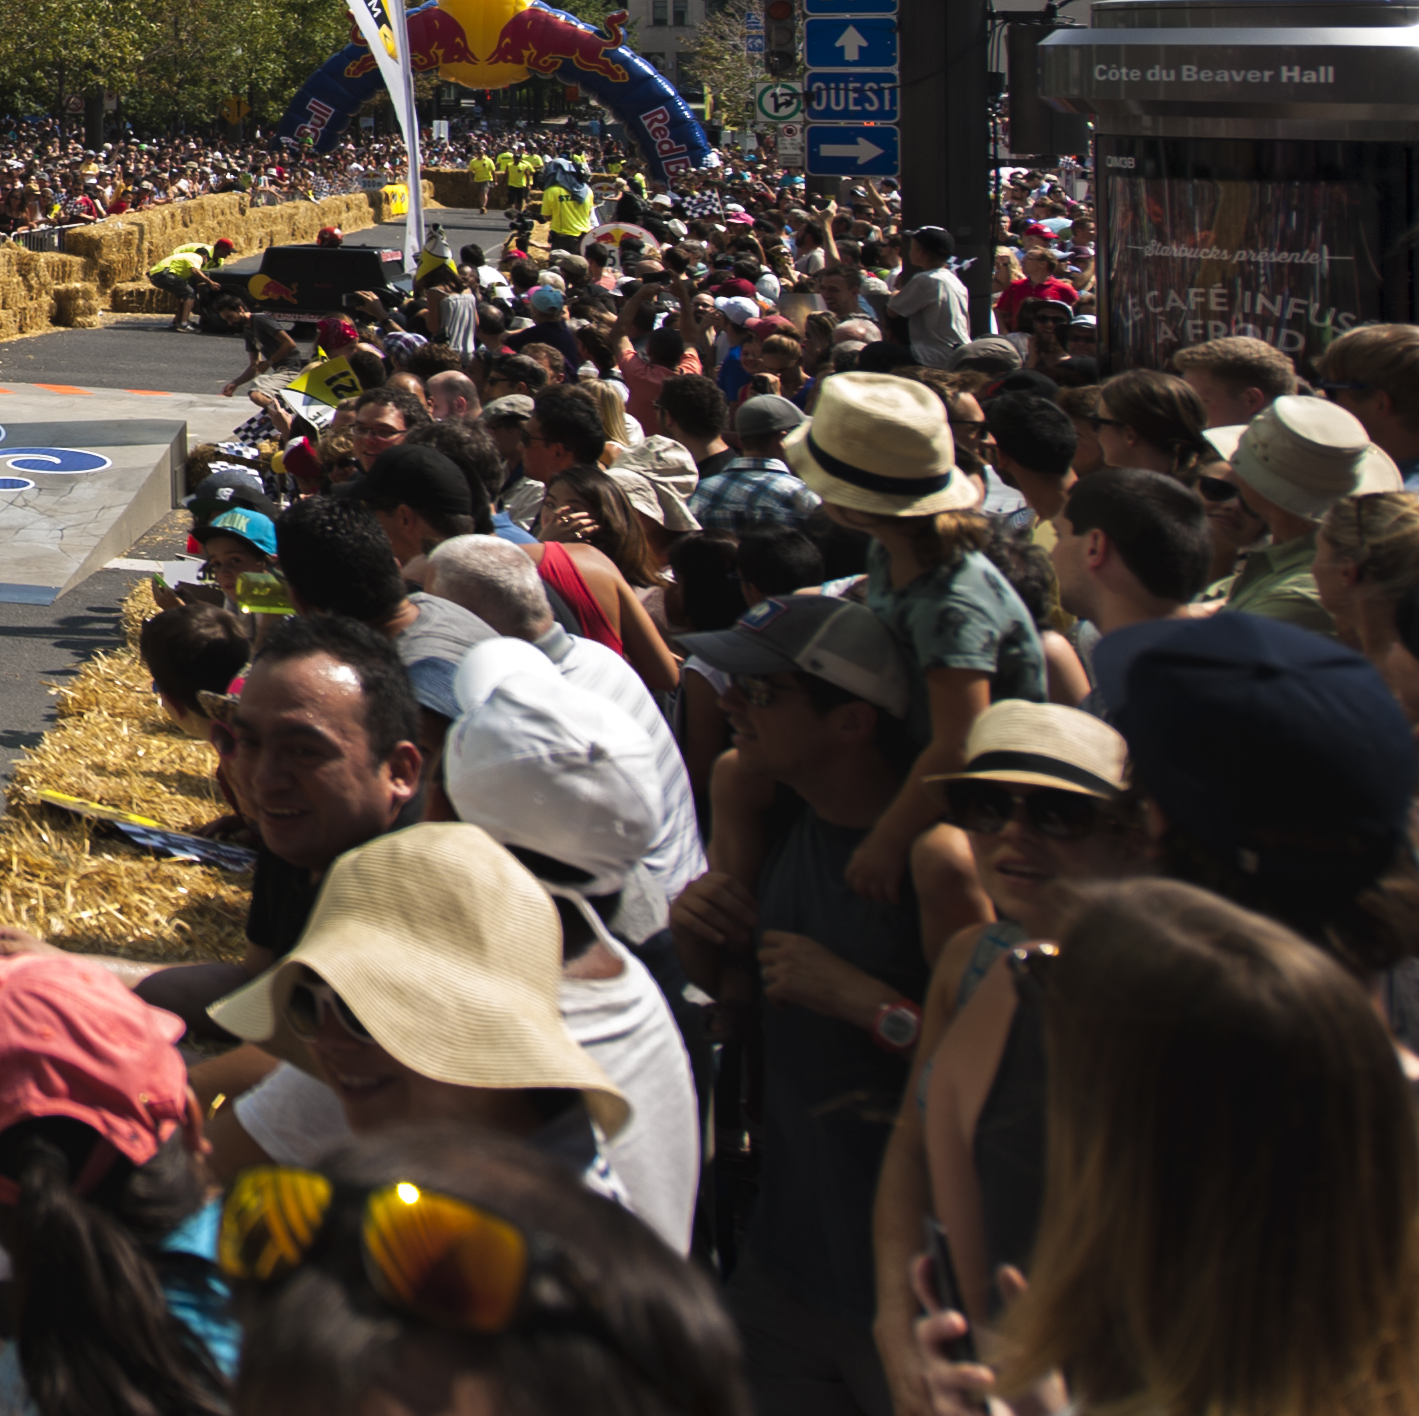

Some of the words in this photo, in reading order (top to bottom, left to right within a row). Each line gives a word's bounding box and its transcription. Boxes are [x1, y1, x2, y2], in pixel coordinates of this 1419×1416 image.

[1094, 63, 1141, 81] Côte
[1146, 65, 1176, 81] du
[1181, 65, 1274, 83] Beaver
[1280, 66, 1335, 83] Hall
[812, 82, 895, 111] OUEST
[639, 105, 687, 158] Red
[1144, 239, 1233, 261] Starbucks
[1232, 246, 1321, 264] présente
[1145, 284, 1229, 313] CAFÉ
[1244, 291, 1374, 334] INFUS
[1157, 317, 1178, 344] À
[1188, 320, 1306, 352] FROID
[324, 370, 359, 399] 21
